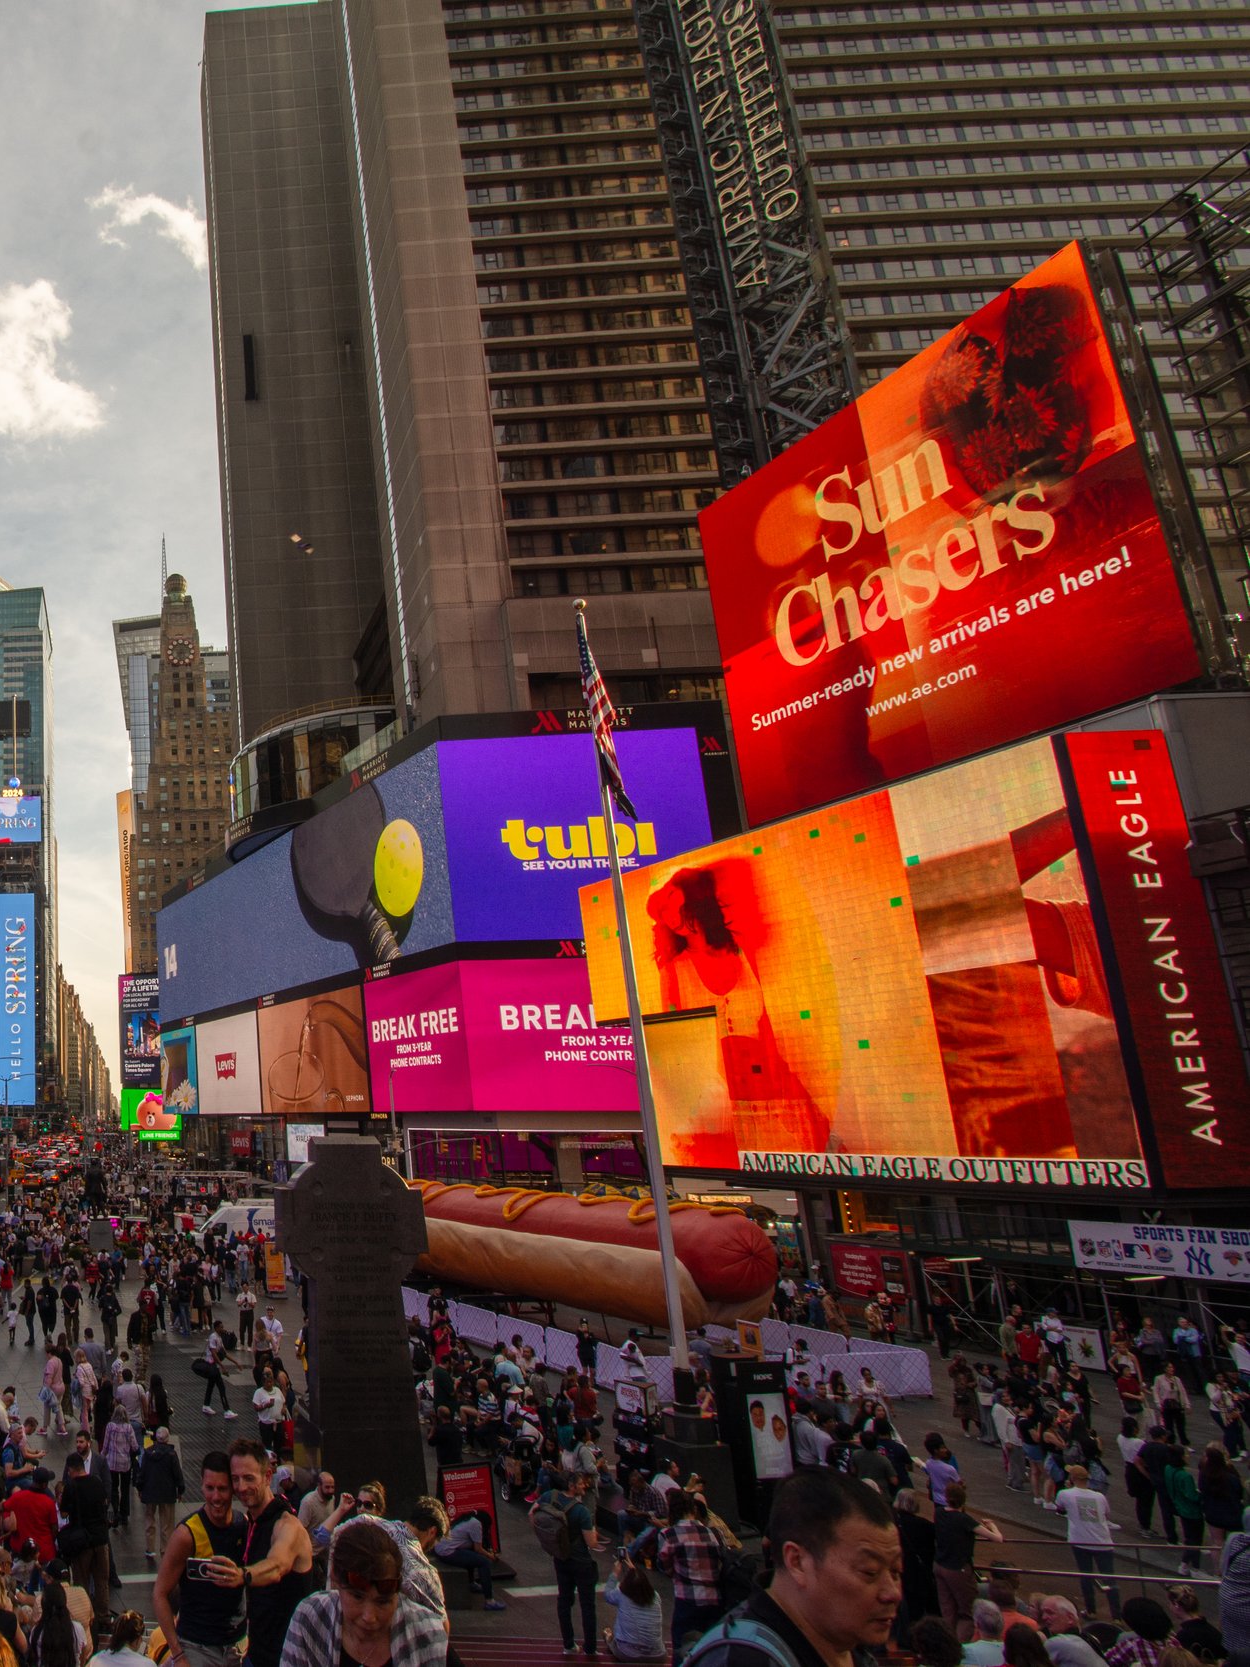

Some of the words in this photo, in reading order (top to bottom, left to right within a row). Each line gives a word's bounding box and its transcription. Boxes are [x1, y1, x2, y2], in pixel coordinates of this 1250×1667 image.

[722, 0, 800, 222] OUTFITTERS
[700, 89, 769, 288] AMERICAN
[814, 438, 953, 564] Sun
[775, 486, 1055, 668] Chasers
[750, 664, 877, 732] Summer-ready
[881, 644, 923, 675] new
[929, 605, 1012, 654] arrivals
[1015, 587, 1055, 618] are
[1060, 547, 1133, 596] here!
[865, 661, 978, 719] www.ae.com
[362, 752, 388, 772] MARRIOTT
[362, 763, 386, 782] MARQUIS
[2, 789, 24, 797] 2024
[500, 816, 658, 861] tubi
[1108, 769, 1165, 889] EAGLE
[522, 861, 546, 871] SEE
[547, 860, 577, 870] YOU
[578, 859, 592, 869] IN
[593, 857, 640, 869] THRE.
[5, 917, 26, 1015] SPRING
[163, 943, 178, 980] 14
[135, 978, 159, 986] OPPORT
[137, 984, 159, 992] LIFETIM
[371, 1014, 417, 1043] BREAK
[420, 1007, 459, 1037] FREE
[561, 1035, 597, 1046] FROM
[600, 1035, 634, 1046] 3-YEA
[1144, 916, 1224, 1146] AMERICAN
[11, 1023, 21, 1081] HELLO
[390, 1058, 408, 1068] PHONE
[409, 1054, 442, 1067] CONTRACTS
[396, 1044, 411, 1054] FROM
[411, 1041, 432, 1053] 3-YEAR
[544, 1051, 587, 1062] PHONE
[590, 1050, 635, 1061] CONTR
[345, 1094, 364, 1102] SEPHORA
[741, 1154, 852, 1177] AMERICAN
[862, 1155, 943, 1181] EAGLE
[950, 1158, 1148, 1189] OUTFITTERS
[1133, 1226, 1184, 1242] SPORTS
[1188, 1229, 1217, 1244] FAN
[1221, 1230, 1250, 1246] SHO
[443, 1470, 478, 1482] Welcome!
